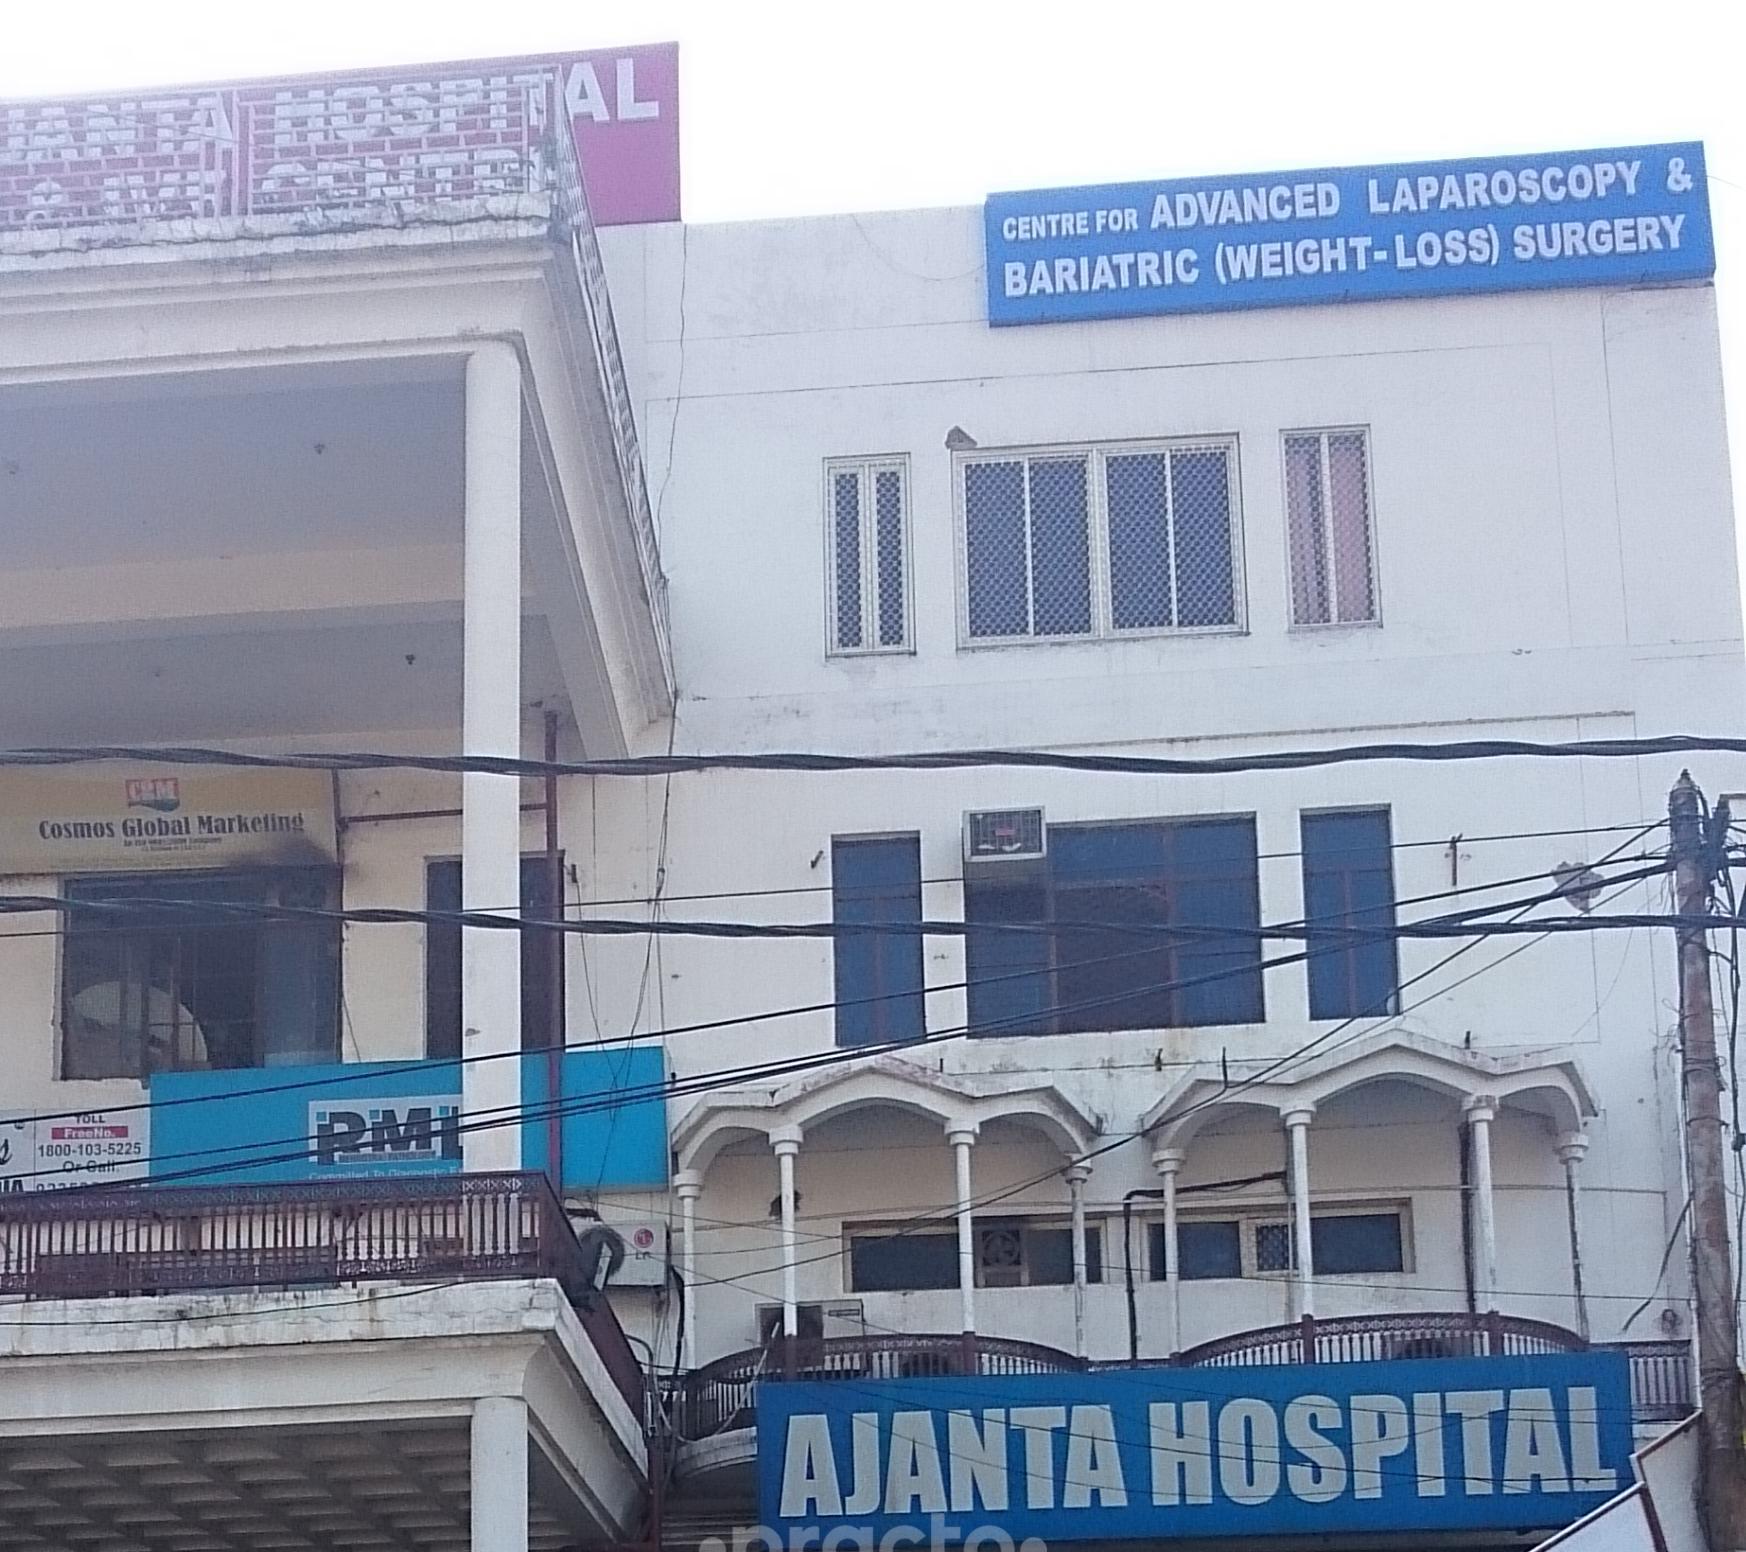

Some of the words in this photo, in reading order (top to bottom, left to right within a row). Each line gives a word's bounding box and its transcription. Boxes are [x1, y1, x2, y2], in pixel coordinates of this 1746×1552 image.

[1003, 211, 1089, 240] CENTRE
[1095, 207, 1139, 233] FOR
[1150, 182, 1340, 228] ADVANCED
[1368, 160, 1641, 213] LAPAROSCOPY
[1667, 156, 1694, 191] &
[1004, 249, 1199, 298] BARIATRIC
[1513, 214, 1685, 260] SURGERY
[38, 819, 116, 840] Cosmos
[121, 816, 191, 838] Global
[197, 812, 304, 834] Marketing
[38, 1142, 142, 1158] 1800-103-5225
[780, 1405, 1128, 1517] AJANTA
[1149, 1387, 1617, 1506] HOSPITAL
